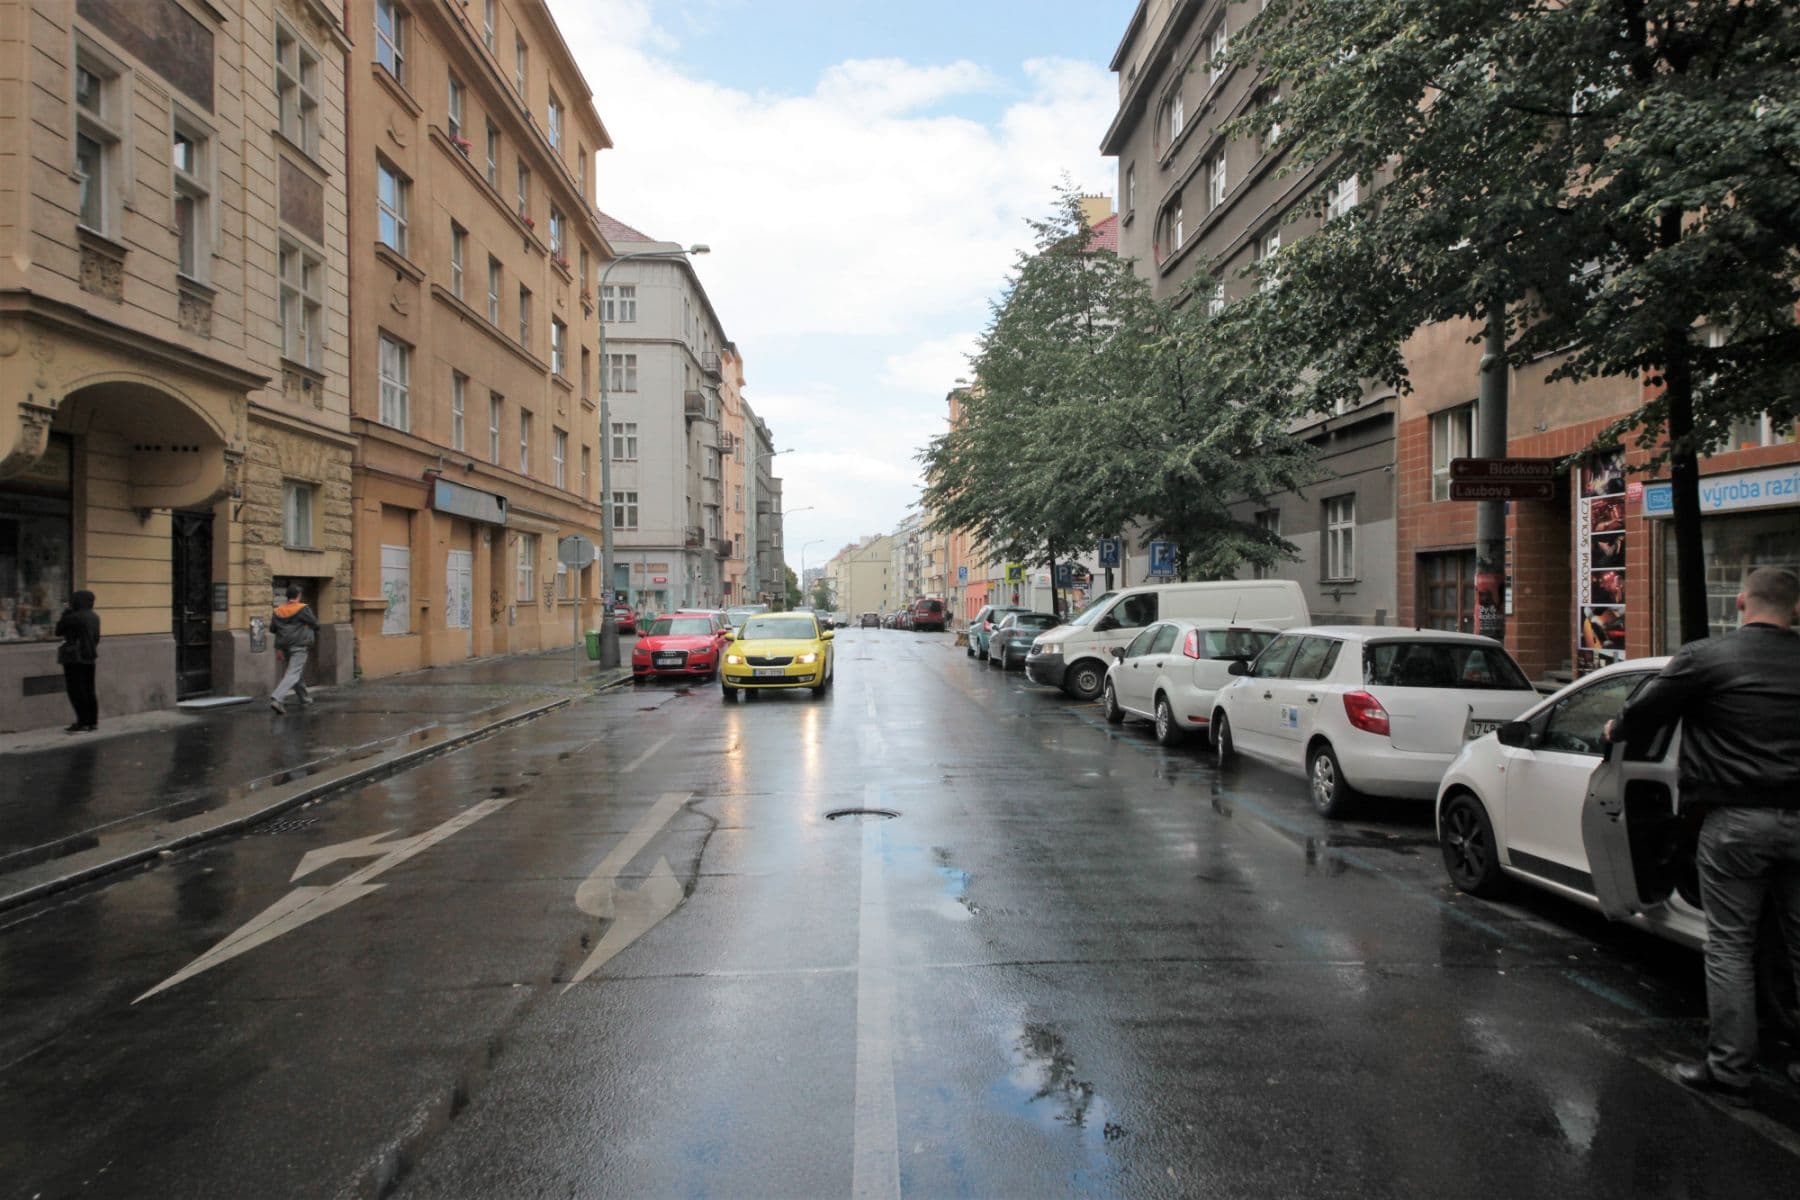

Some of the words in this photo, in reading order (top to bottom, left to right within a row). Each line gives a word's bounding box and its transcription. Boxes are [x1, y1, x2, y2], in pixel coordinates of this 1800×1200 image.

[1489, 462, 1549, 475] Blodkova
[1456, 484, 1511, 497] Laubova
[1703, 479, 1760, 507] výroba
[1765, 472, 1800, 496] razí
